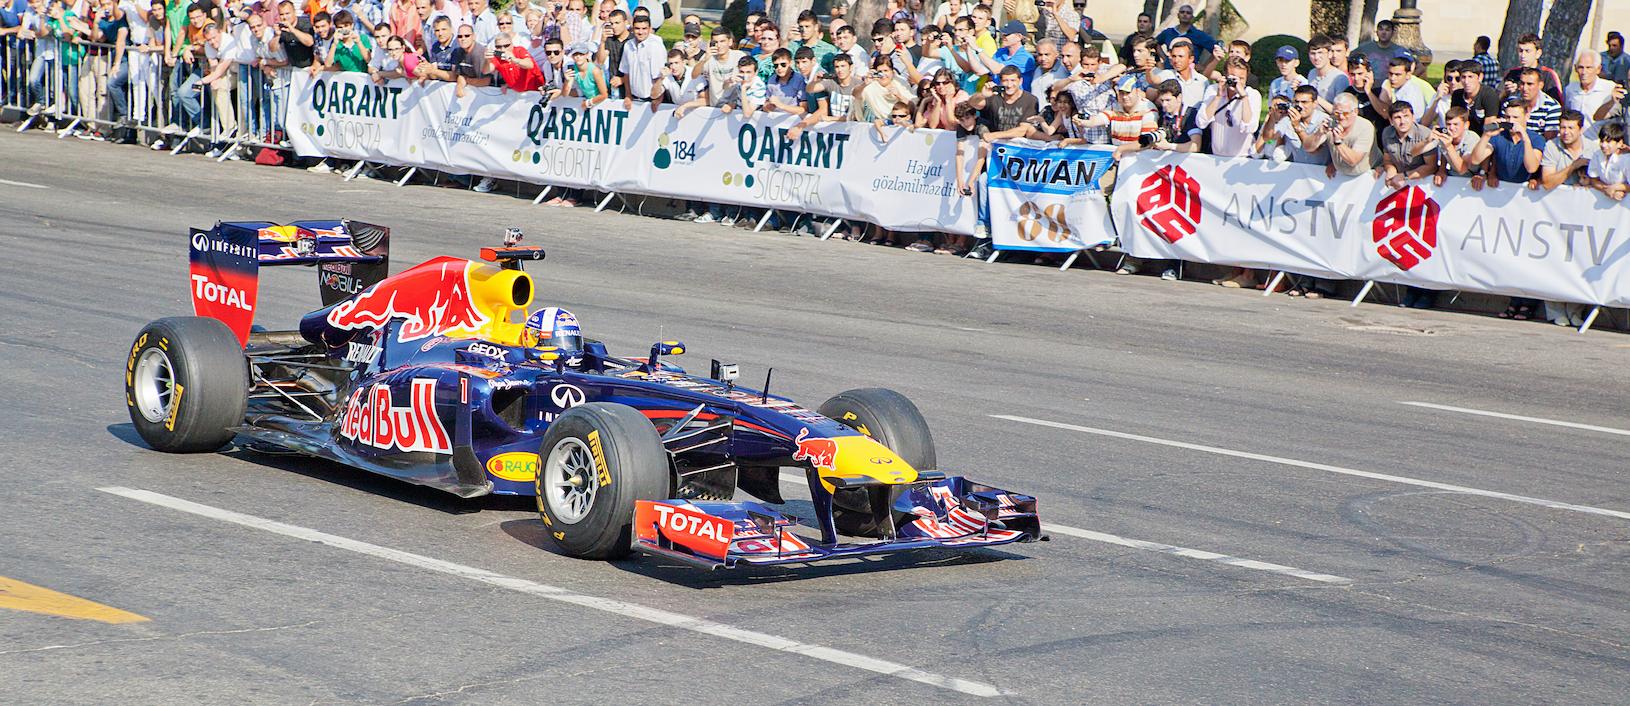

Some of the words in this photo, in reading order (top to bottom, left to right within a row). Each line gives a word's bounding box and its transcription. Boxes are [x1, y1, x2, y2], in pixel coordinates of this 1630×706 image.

[312, 79, 402, 119] QARANT
[527, 105, 629, 145] QARANT
[673, 140, 696, 161] 184
[738, 123, 850, 169] QARANT
[905, 159, 943, 179] Həyat
[555, 329, 582, 338] RENAUL
[346, 341, 384, 364] RENAULT
[467, 342, 510, 362] GEOX
[460, 377, 468, 405] 1
[505, 460, 537, 473] RAUC
[653, 504, 729, 544] TOTAL
